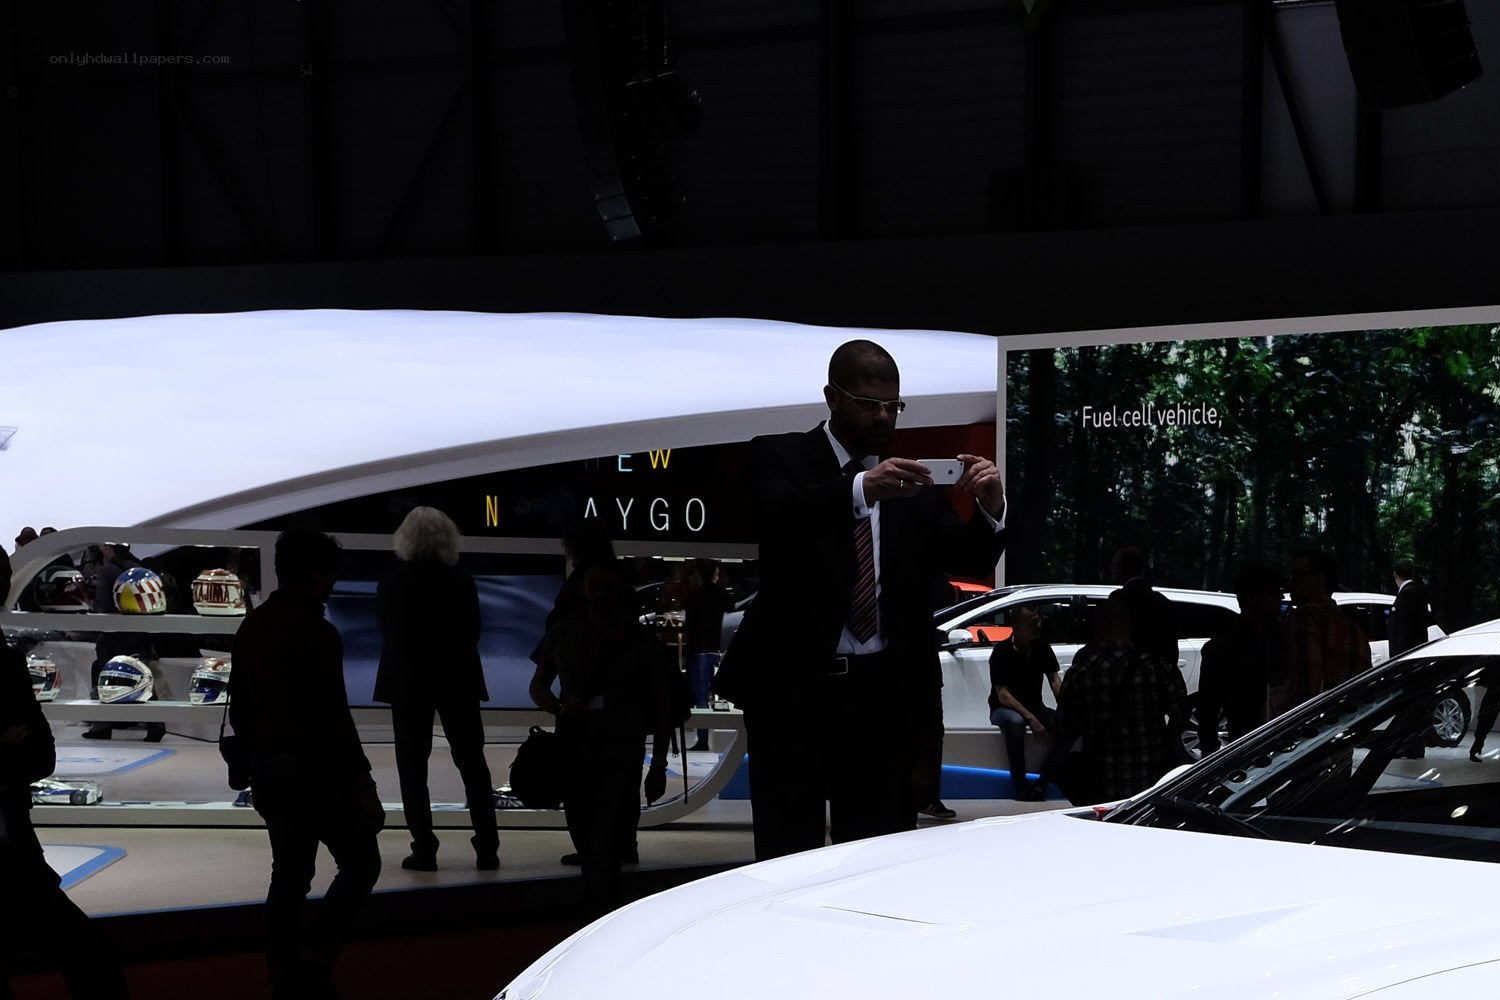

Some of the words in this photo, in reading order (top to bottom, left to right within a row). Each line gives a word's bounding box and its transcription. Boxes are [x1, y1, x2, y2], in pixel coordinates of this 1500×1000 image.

[1082, 404, 1118, 429] Fuel
[1122, 402, 1153, 428] cell
[1156, 400, 1223, 429] vehicle,
[583, 496, 706, 532] AYGO
